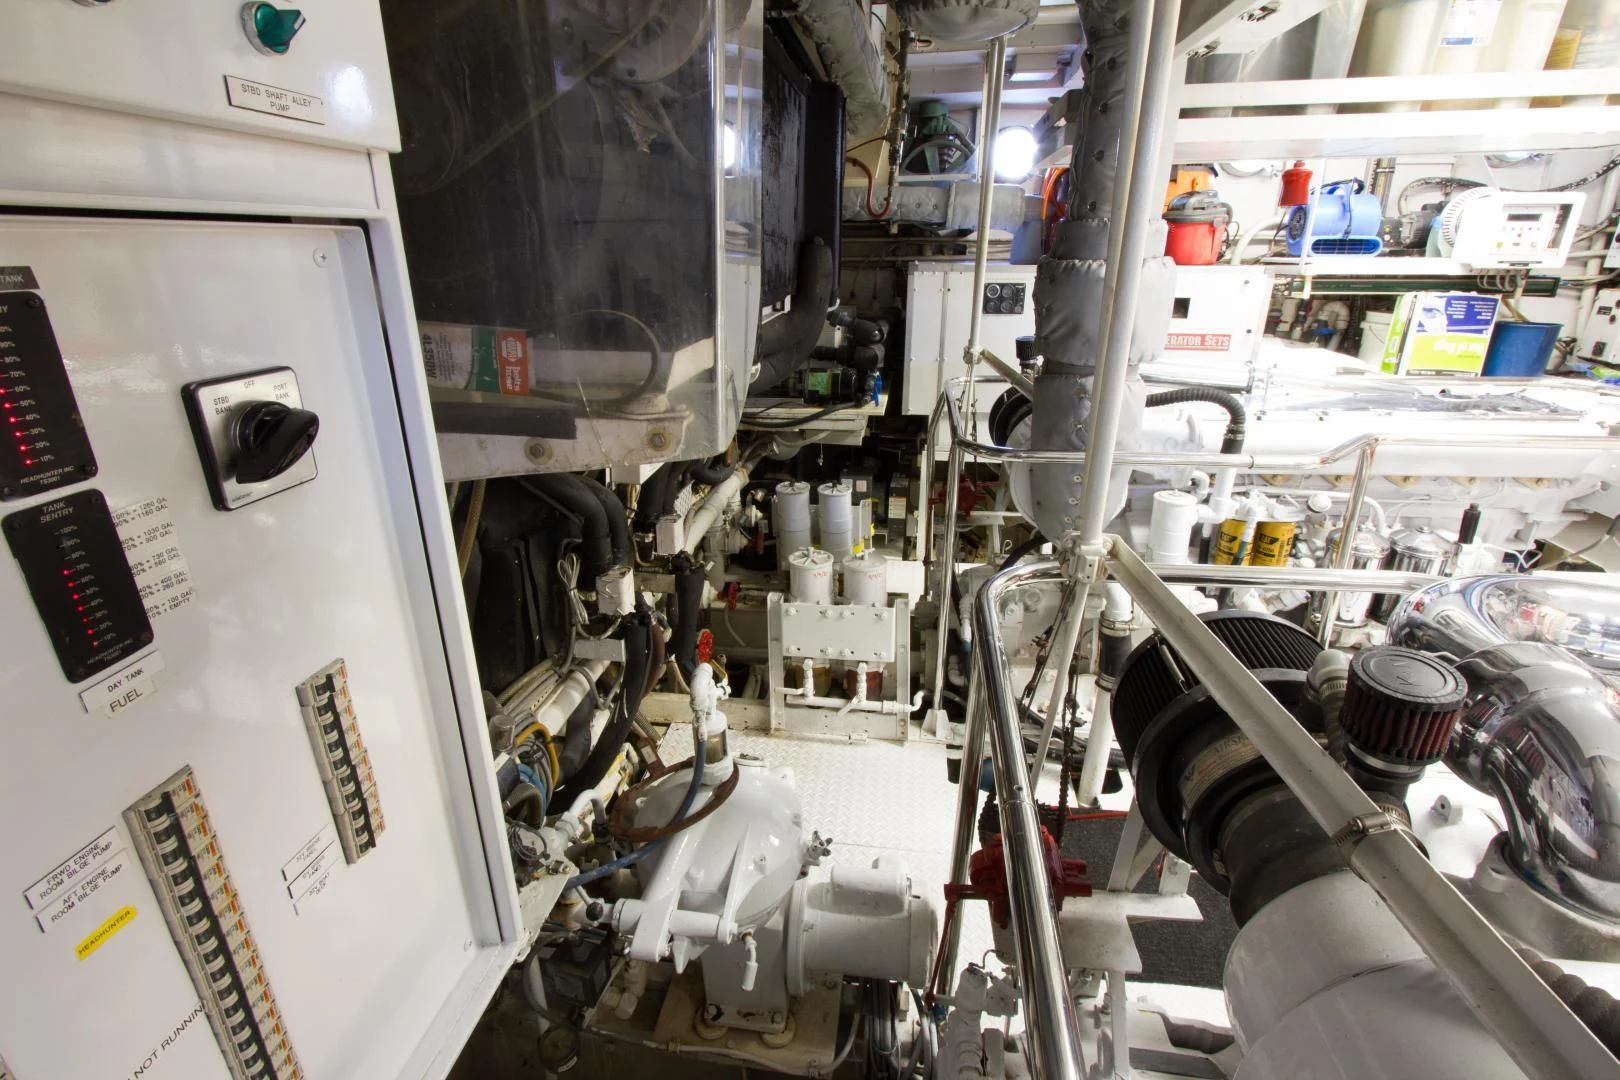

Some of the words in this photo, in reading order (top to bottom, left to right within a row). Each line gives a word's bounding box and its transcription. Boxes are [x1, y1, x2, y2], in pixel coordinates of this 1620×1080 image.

[241, 83, 261, 96] STBD
[265, 89, 288, 101] SHAFT
[292, 96, 312, 107] ALLEY
[269, 101, 291, 112] PUMP
[213, 396, 230, 406] STBD
[215, 404, 232, 416] BANK
[20, 467, 63, 485] HEADHUNTER
[40, 506, 74, 523] SENTRY
[42, 501, 66, 513] TANK
[107, 680, 122, 693] DAY
[125, 667, 145, 682] TANK
[109, 688, 143, 713] FUEL
[40, 878, 65, 900] ROOM
[66, 858, 91, 880] BILGE
[92, 841, 113, 860] PUMP
[46, 864, 72, 886] FRWD
[73, 842, 102, 866] ENGINE
[51, 901, 75, 923] ROOM
[77, 882, 101, 903] BILGE
[102, 863, 123, 882] PUMP
[62, 890, 79, 906] AFT
[81, 866, 109, 892] ENGINE
[78, 909, 131, 956] HEADHUNTER
[133, 1048, 158, 1079] NOT
